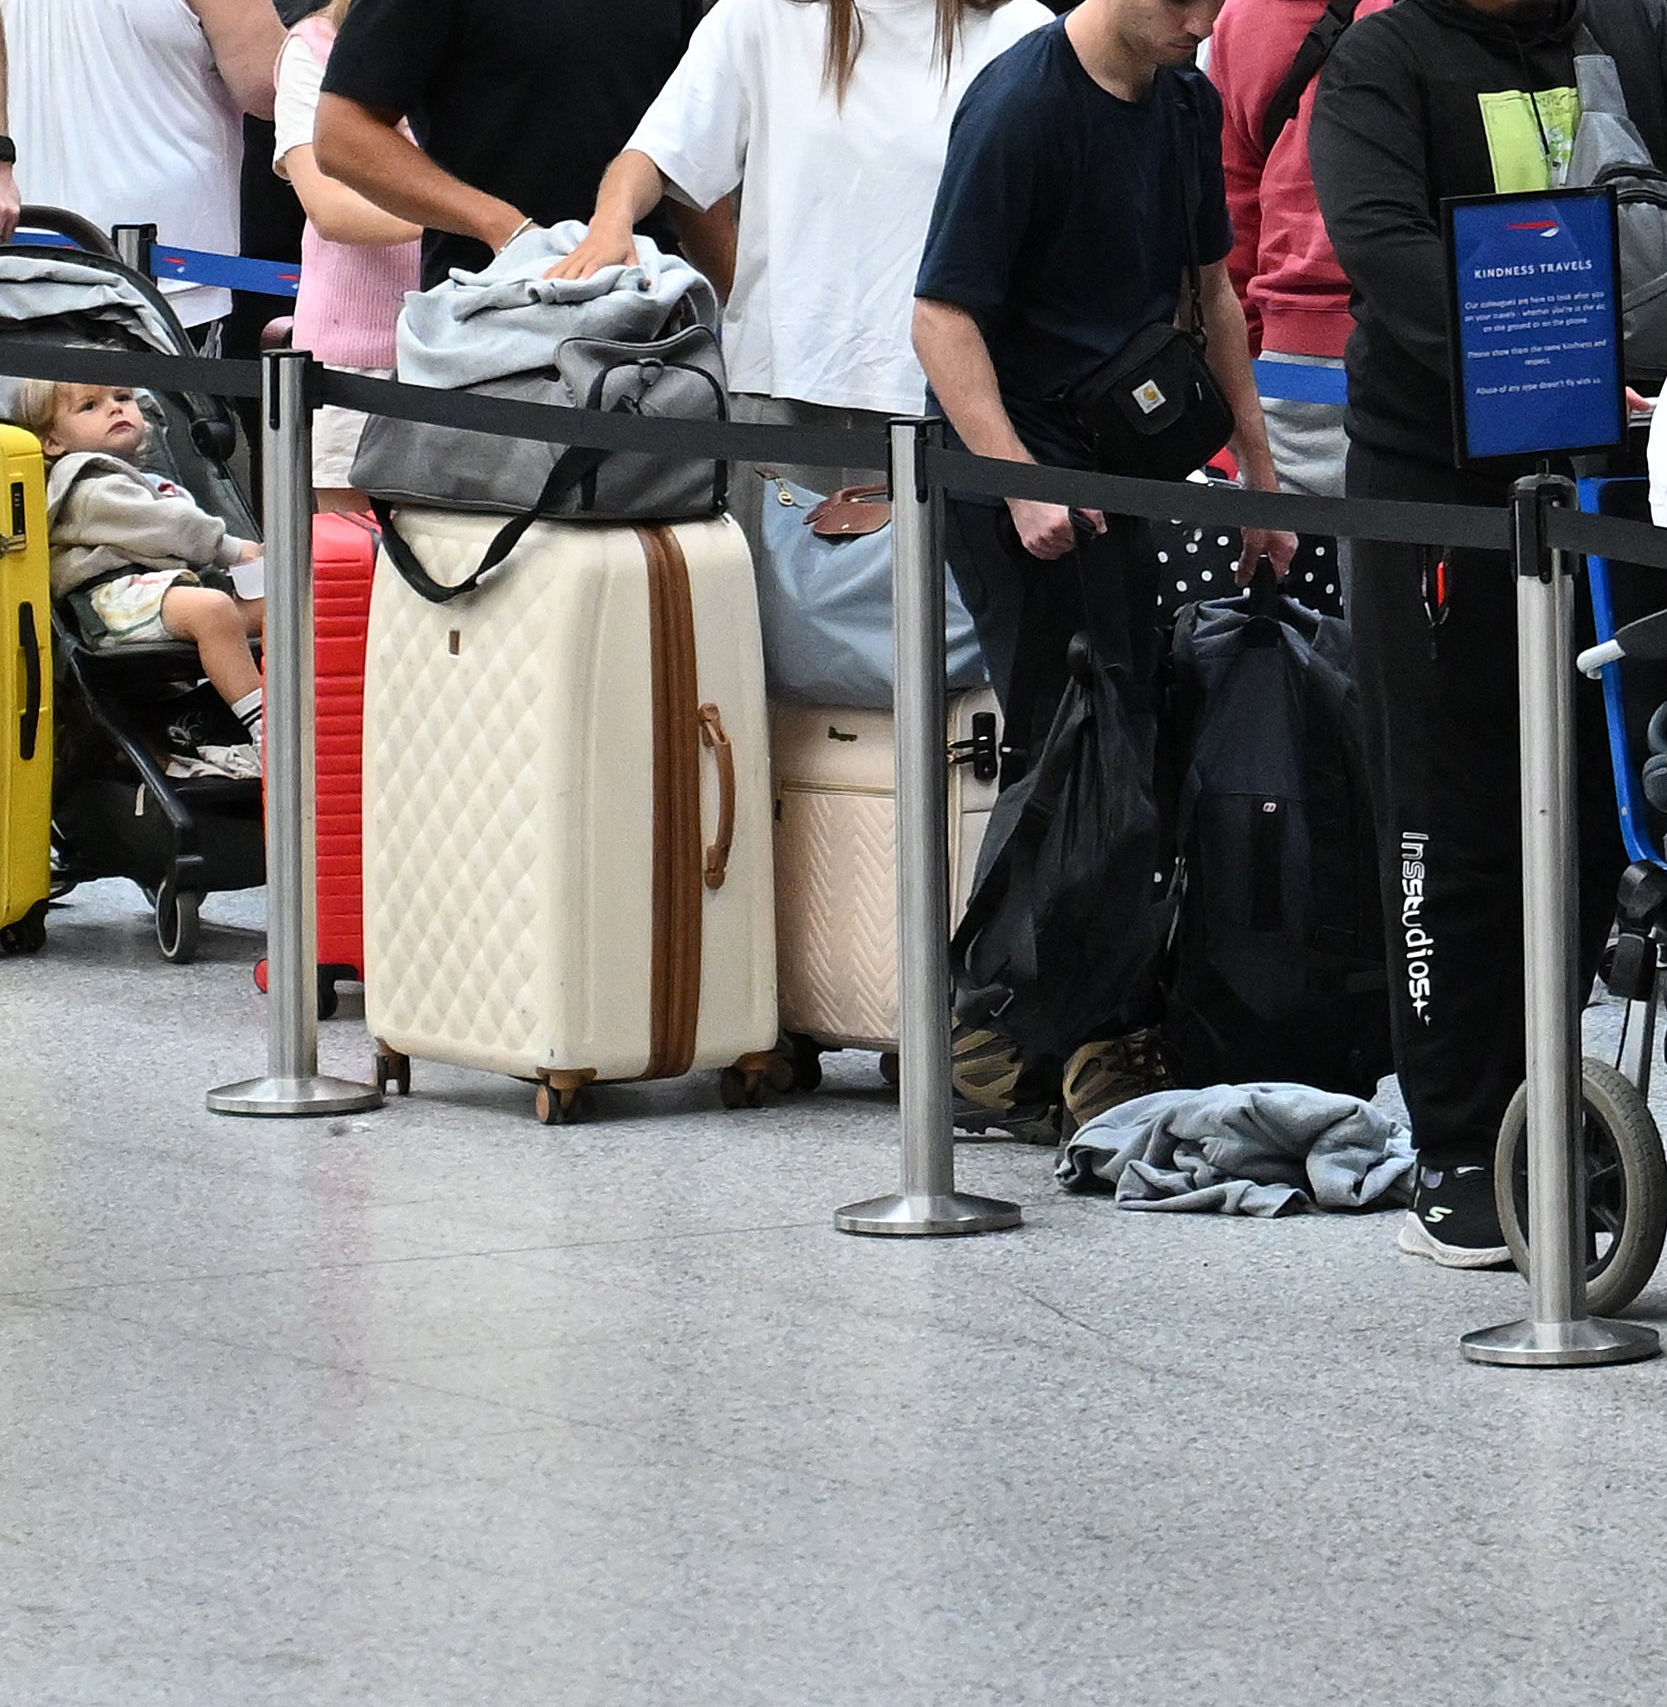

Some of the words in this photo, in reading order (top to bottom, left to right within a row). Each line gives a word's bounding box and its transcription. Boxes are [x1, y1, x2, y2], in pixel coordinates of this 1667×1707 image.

[1474, 265, 1535, 279] KINDNESS
[1539, 260, 1592, 273] TRAVELS
[1465, 302, 1478, 310] Our
